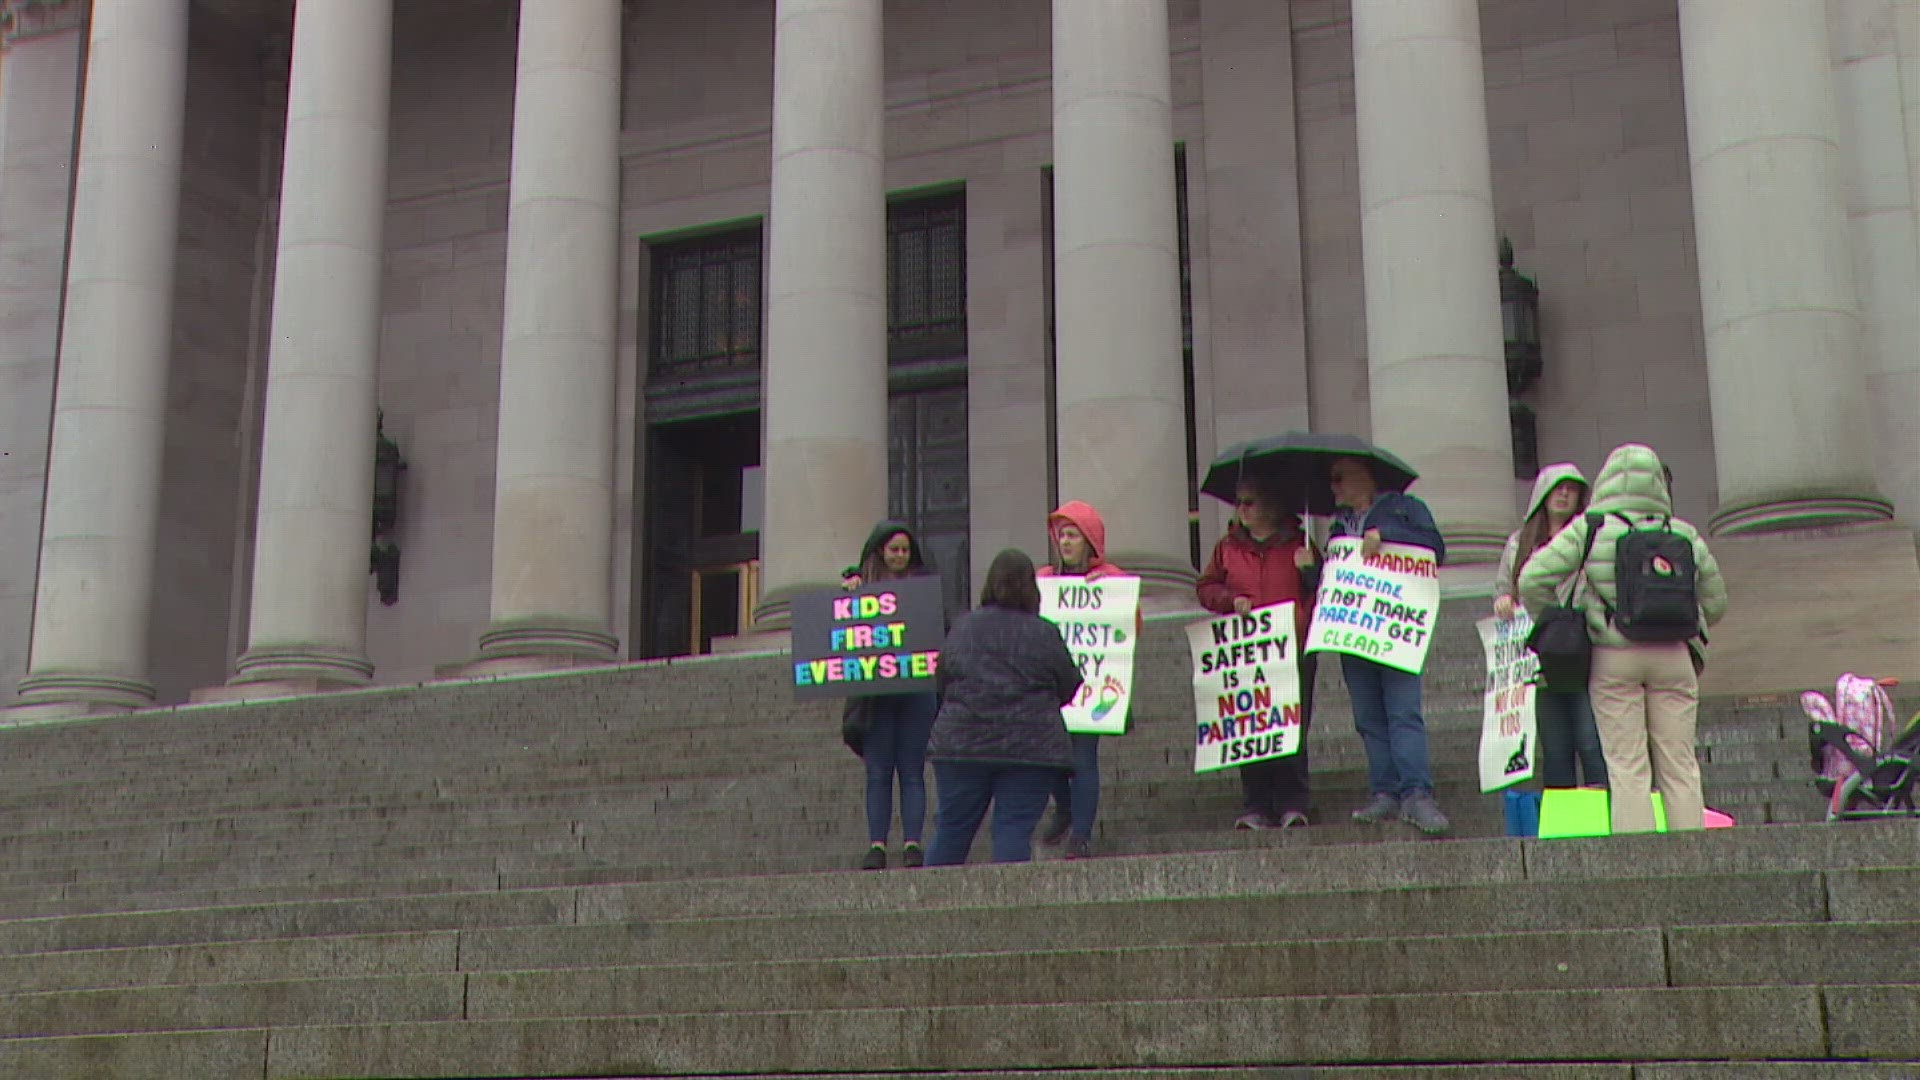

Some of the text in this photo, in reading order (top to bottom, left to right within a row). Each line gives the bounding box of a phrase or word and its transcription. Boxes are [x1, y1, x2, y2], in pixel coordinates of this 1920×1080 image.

[1058, 585, 1103, 610] KIDS
[1335, 568, 1404, 599] VACCINE
[833, 592, 897, 620] KIDS
[1331, 587, 1367, 609] NOT
[1373, 597, 1428, 626] MAKE
[831, 621, 906, 651] FIRST
[1061, 622, 1112, 647] IRST
[1212, 610, 1272, 645] KIDS
[1319, 605, 1427, 647] PARENT GET
[1202, 634, 1288, 674] SAFETY
[1322, 629, 1394, 656] CLEAN?
[795, 655, 877, 686] EVERY
[1222, 666, 1266, 689] IS A
[1218, 687, 1272, 718] NON
[1198, 704, 1301, 745] PARTISAN
[1221, 731, 1284, 764] ISSUE
